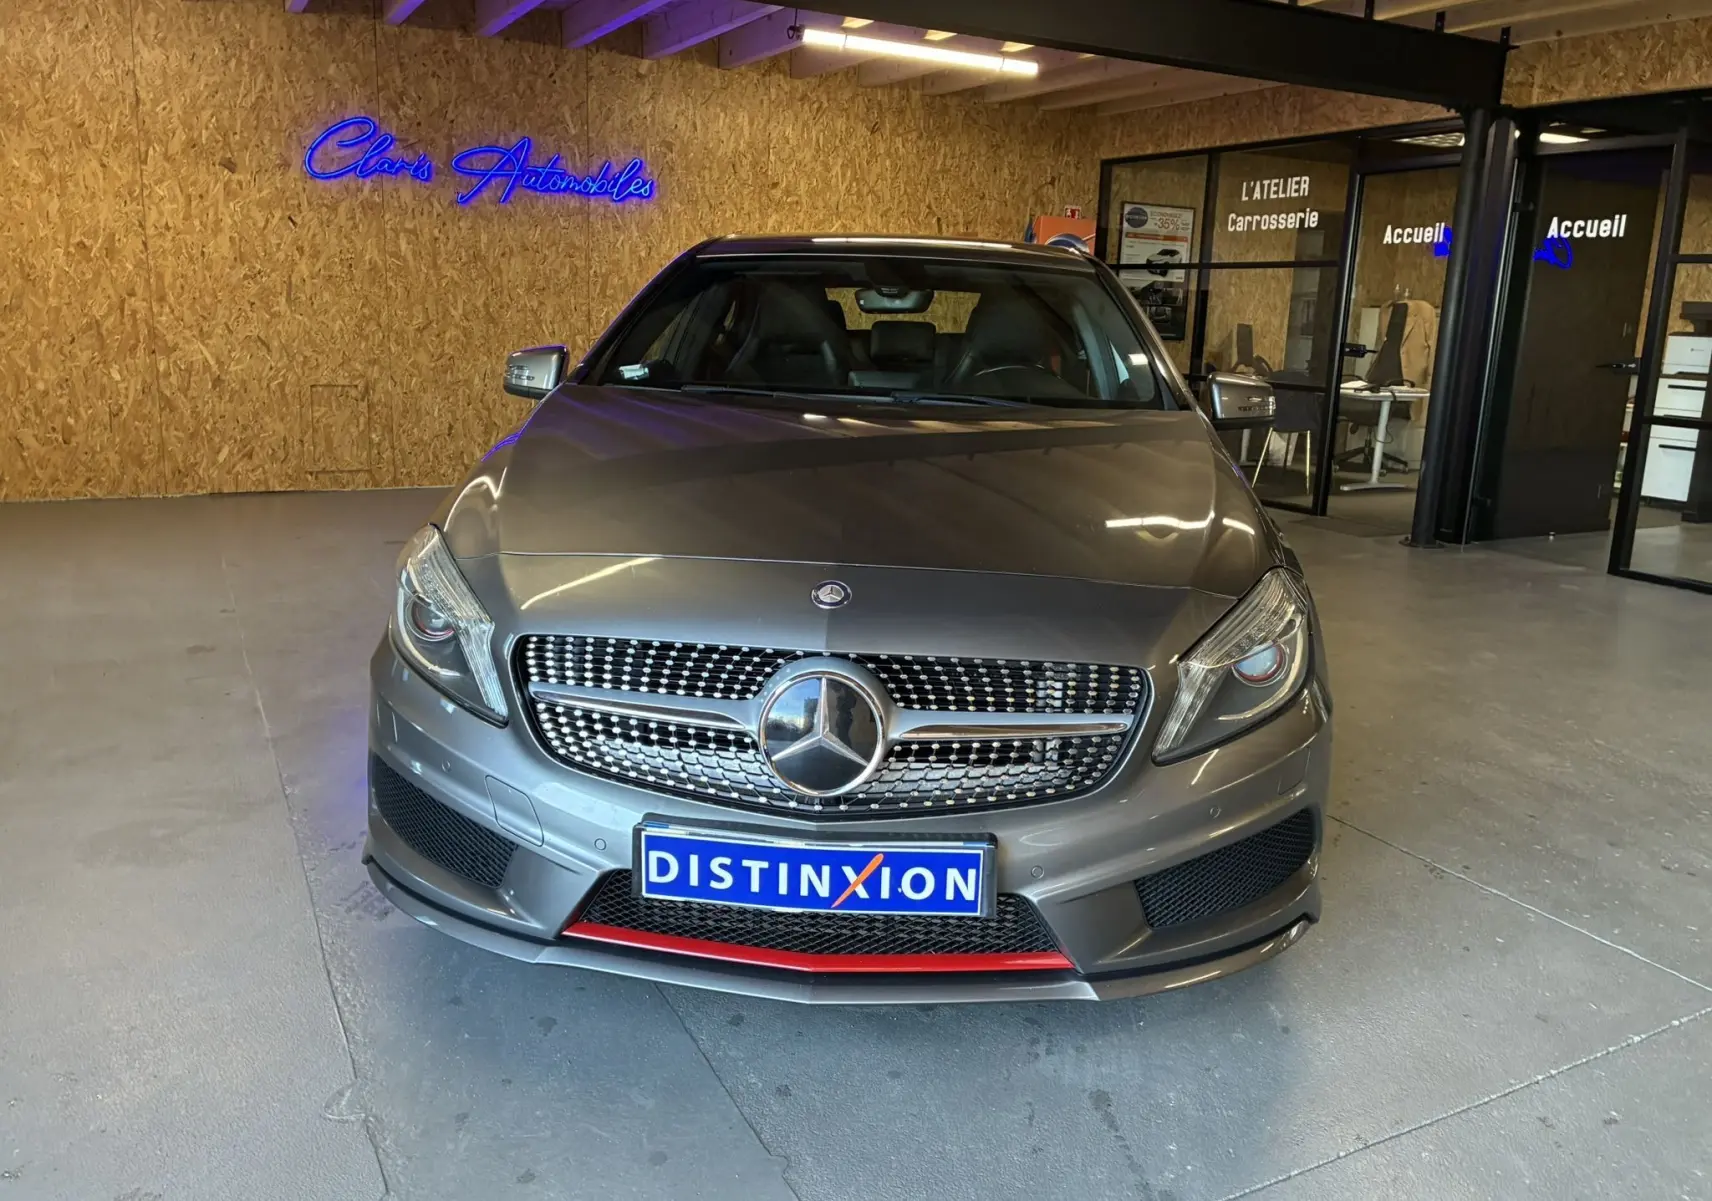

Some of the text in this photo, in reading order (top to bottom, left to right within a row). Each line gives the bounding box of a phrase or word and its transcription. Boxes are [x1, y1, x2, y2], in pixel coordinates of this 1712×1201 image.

[304, 116, 656, 204] Claris Automobiles
[1241, 176, 1310, 201] L'ATELIER
[1227, 208, 1319, 233] Carrosserie
[1546, 214, 1628, 239] Accueil
[1383, 222, 1445, 245] Accueil
[648, 849, 977, 909] DISTINXION
